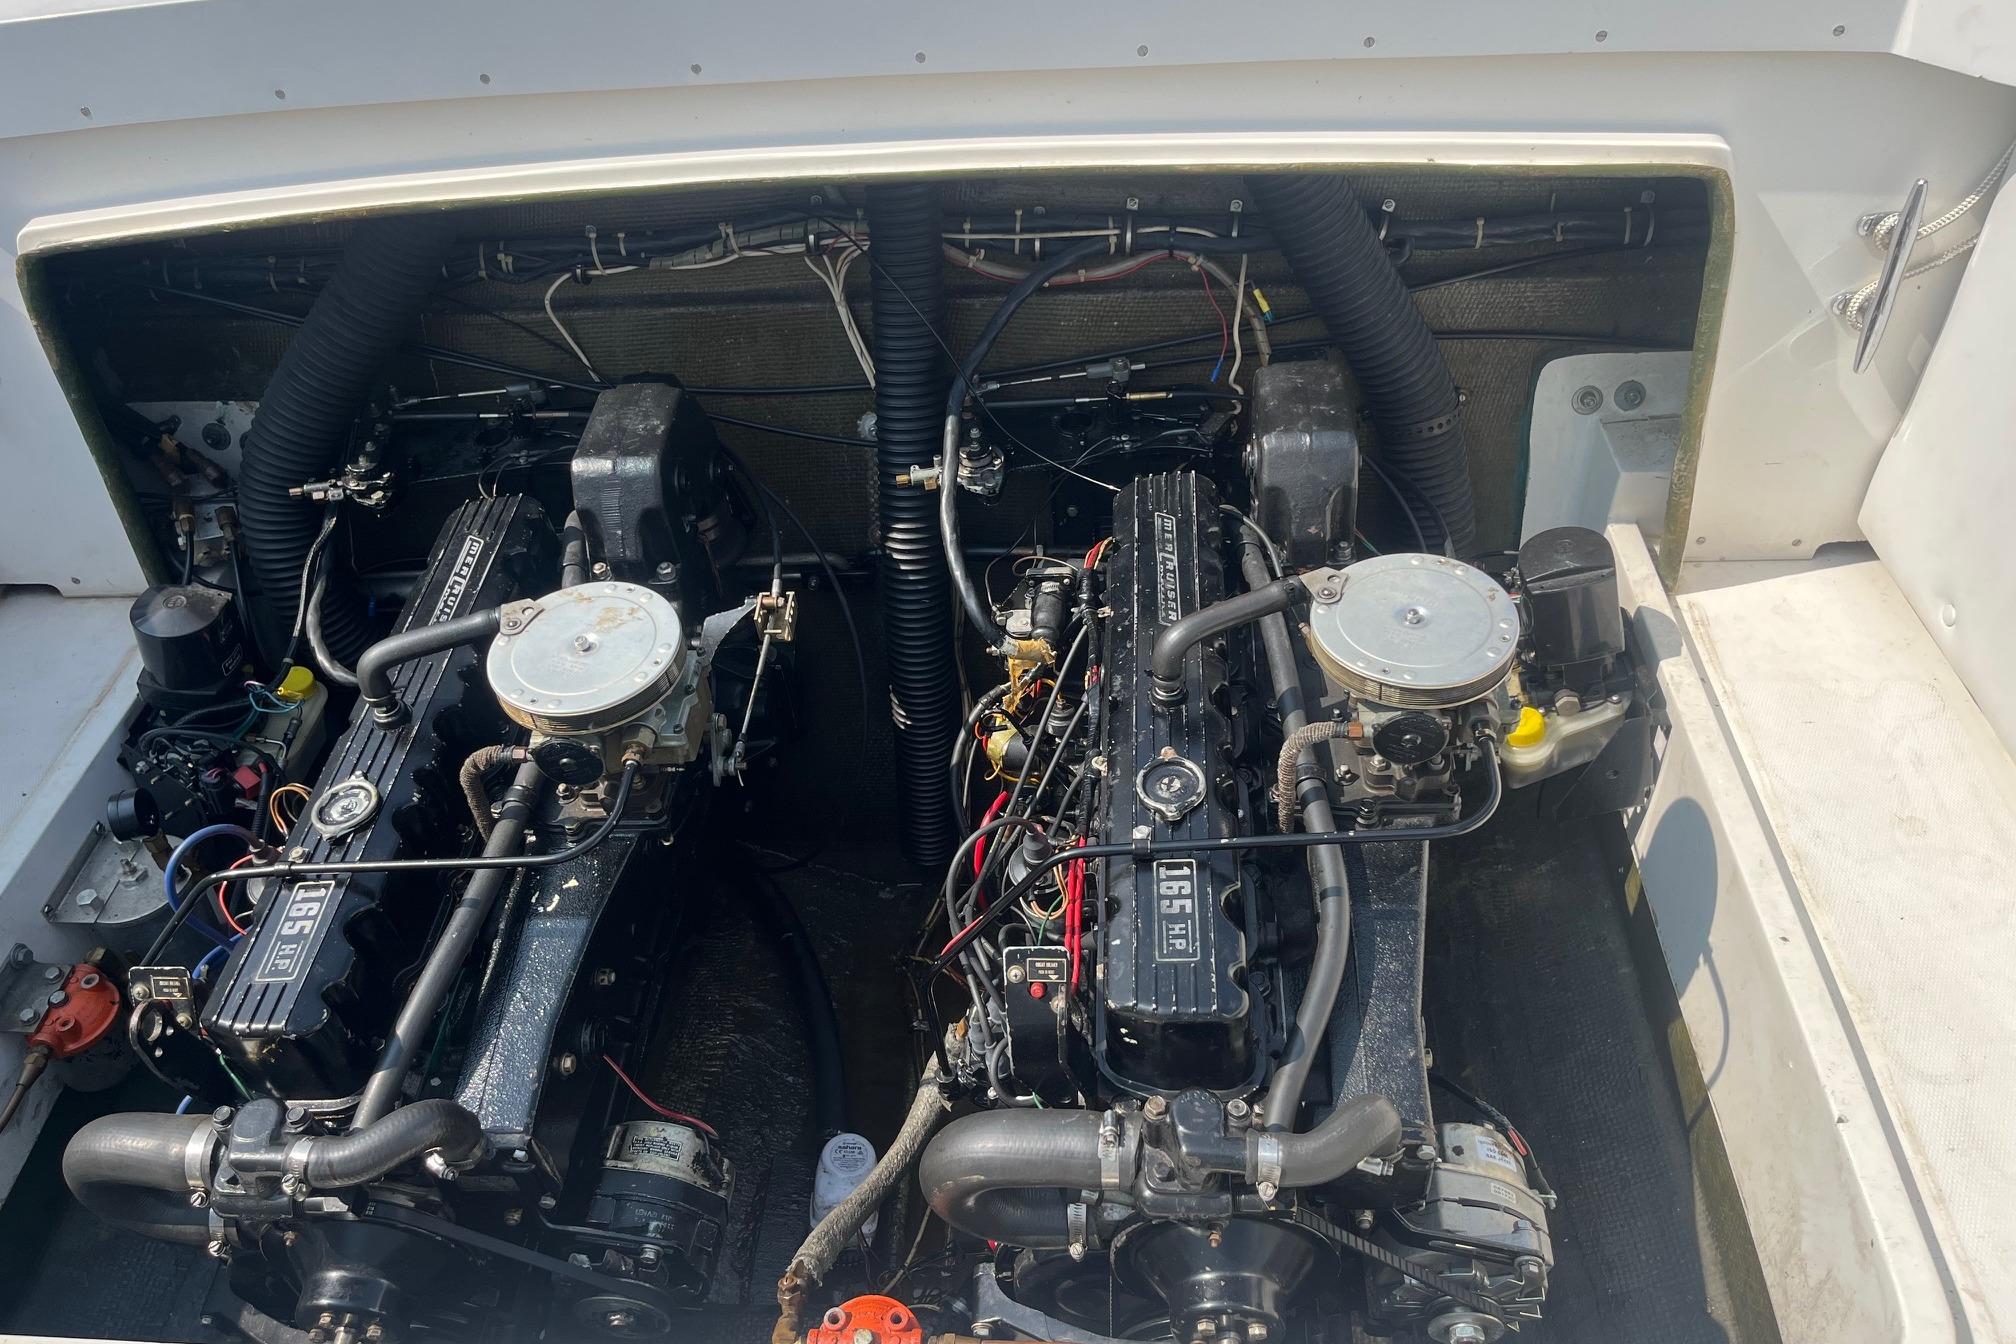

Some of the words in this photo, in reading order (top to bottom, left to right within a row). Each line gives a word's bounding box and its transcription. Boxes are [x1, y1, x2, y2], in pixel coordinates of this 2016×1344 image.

[439, 542, 480, 623] MERCRUIS
[281, 888, 326, 935] 165
[1159, 864, 1192, 914] 165
[271, 943, 298, 970] H.P.
[1168, 923, 1187, 950] H.P.
